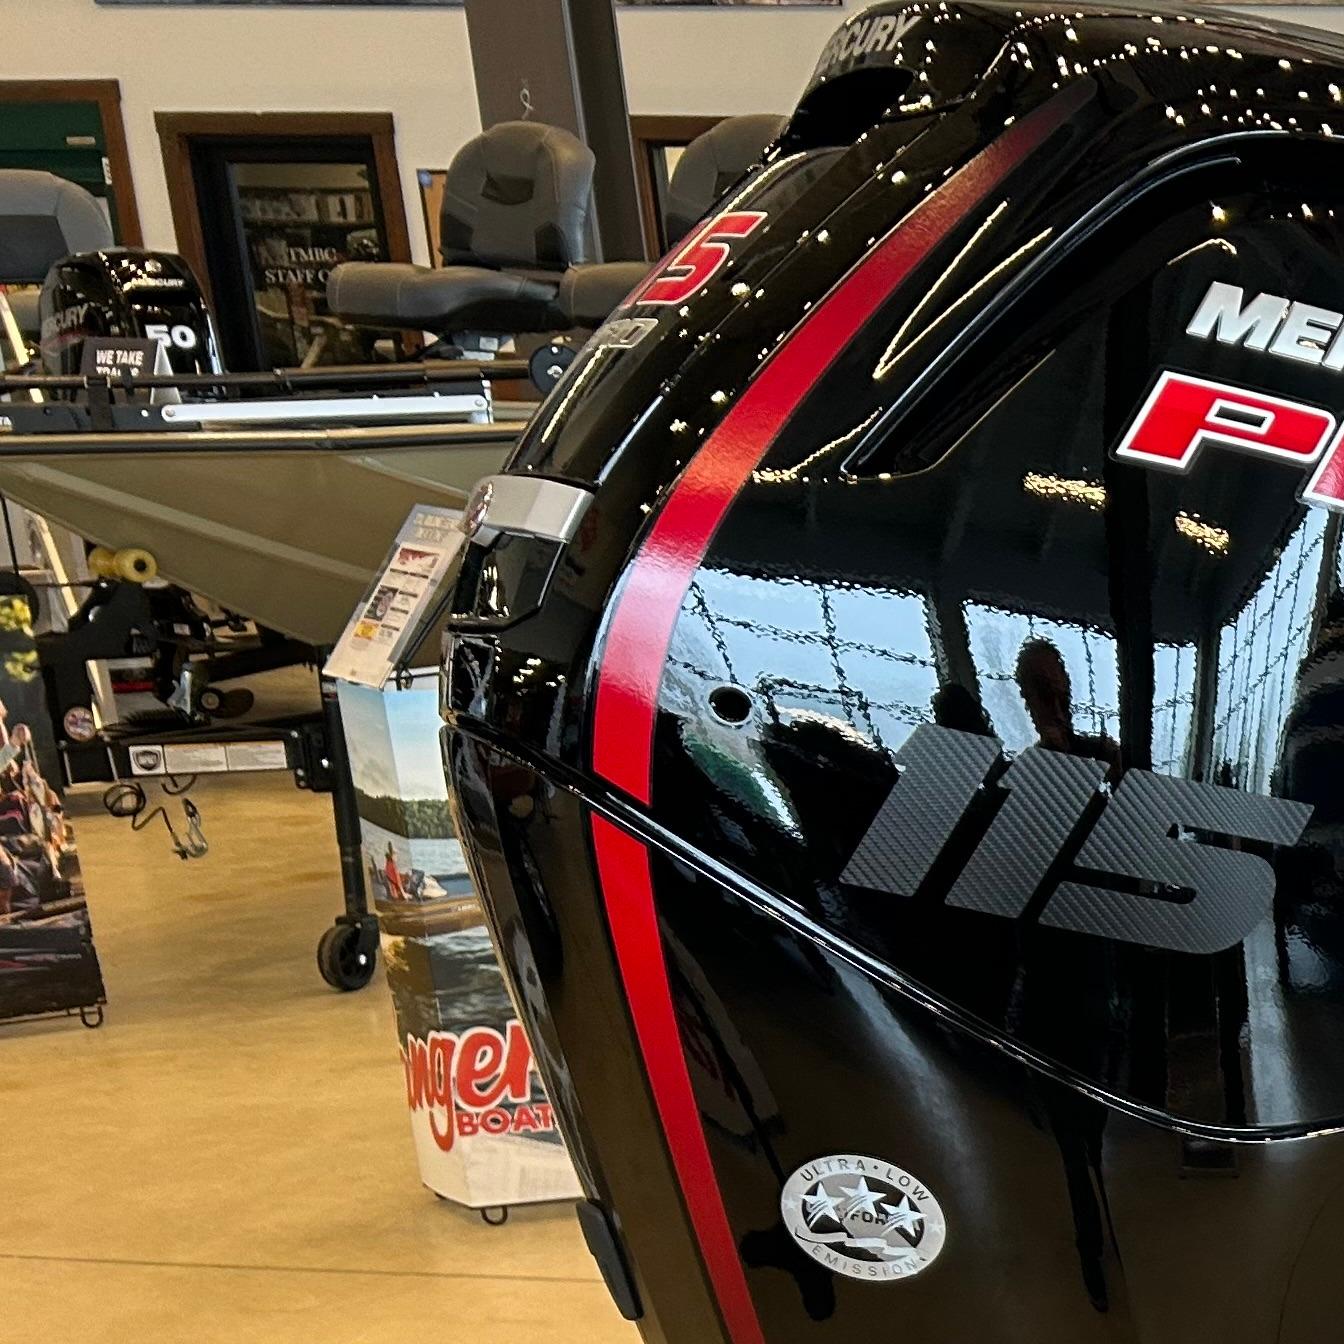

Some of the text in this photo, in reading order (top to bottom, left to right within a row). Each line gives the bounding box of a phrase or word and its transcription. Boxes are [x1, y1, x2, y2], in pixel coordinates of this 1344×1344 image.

[264, 269, 316, 283] STAFF
[145, 325, 197, 349] 50
[96, 350, 144, 366] WE TAKE
[839, 722, 1315, 955] 115
[401, 1020, 532, 1153] nger
[454, 1104, 554, 1137] BOAT
[800, 1158, 931, 1203] ULTRA LOW
[811, 1243, 919, 1278] EMISSION
